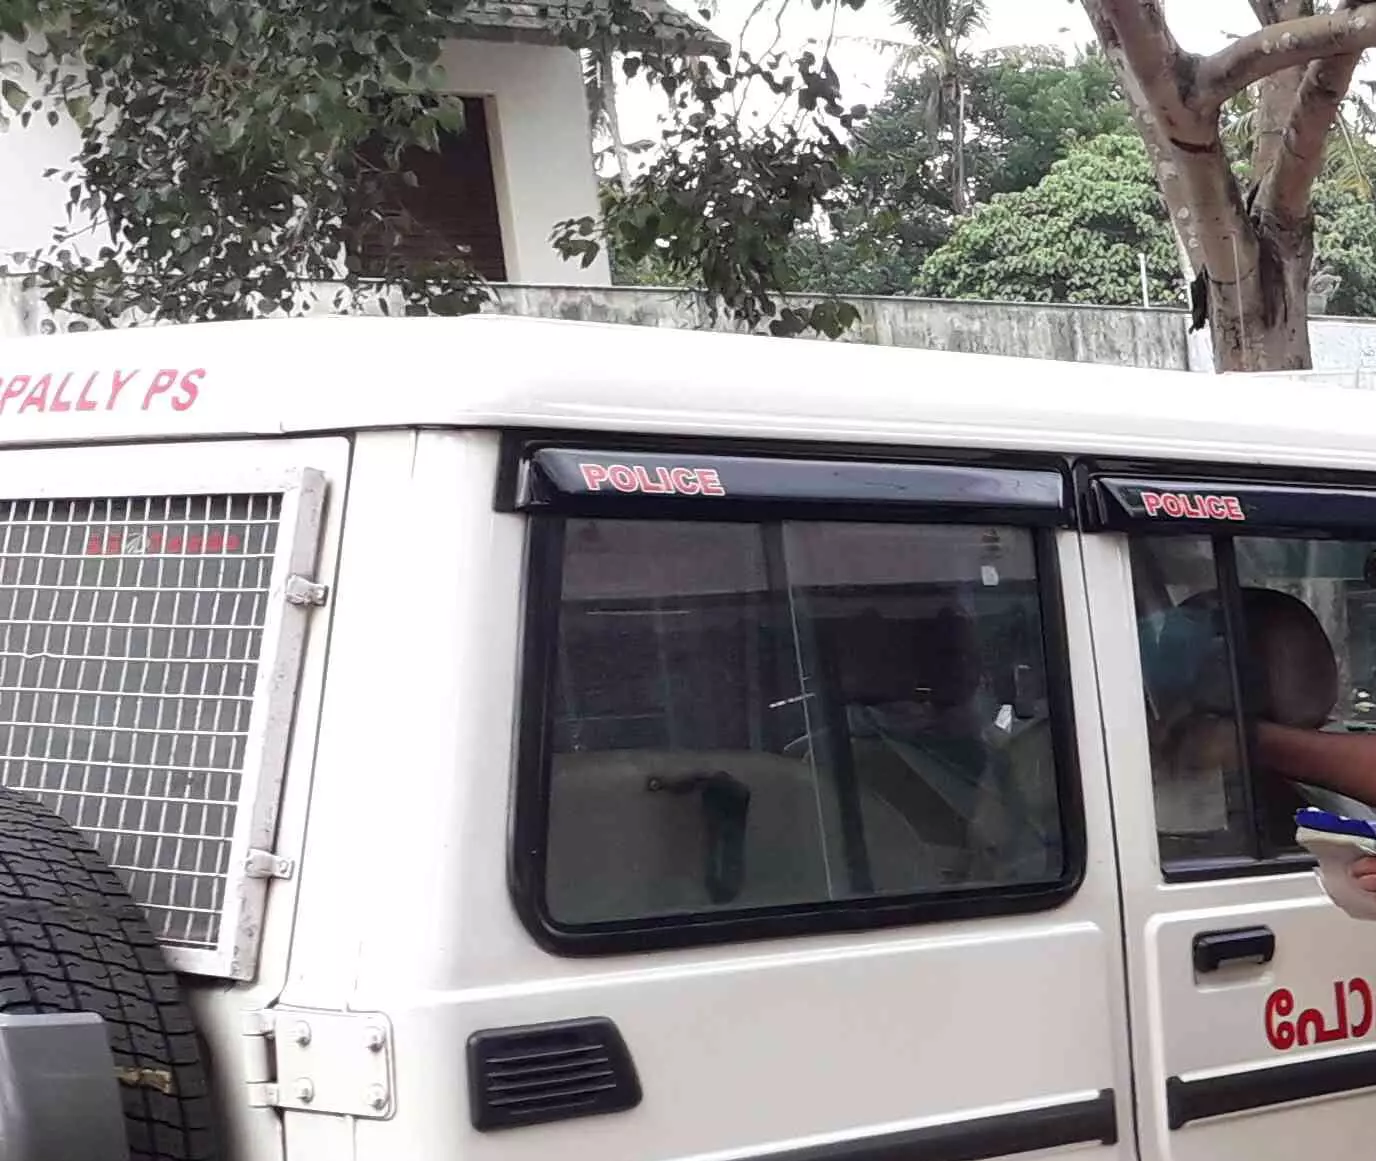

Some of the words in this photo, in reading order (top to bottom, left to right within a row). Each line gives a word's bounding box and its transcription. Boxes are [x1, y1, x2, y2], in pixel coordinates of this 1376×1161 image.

[0, 369, 140, 415] PALLY
[141, 368, 206, 411] PS
[580, 463, 726, 496] POLICE
[1141, 492, 1246, 520] POLICE
